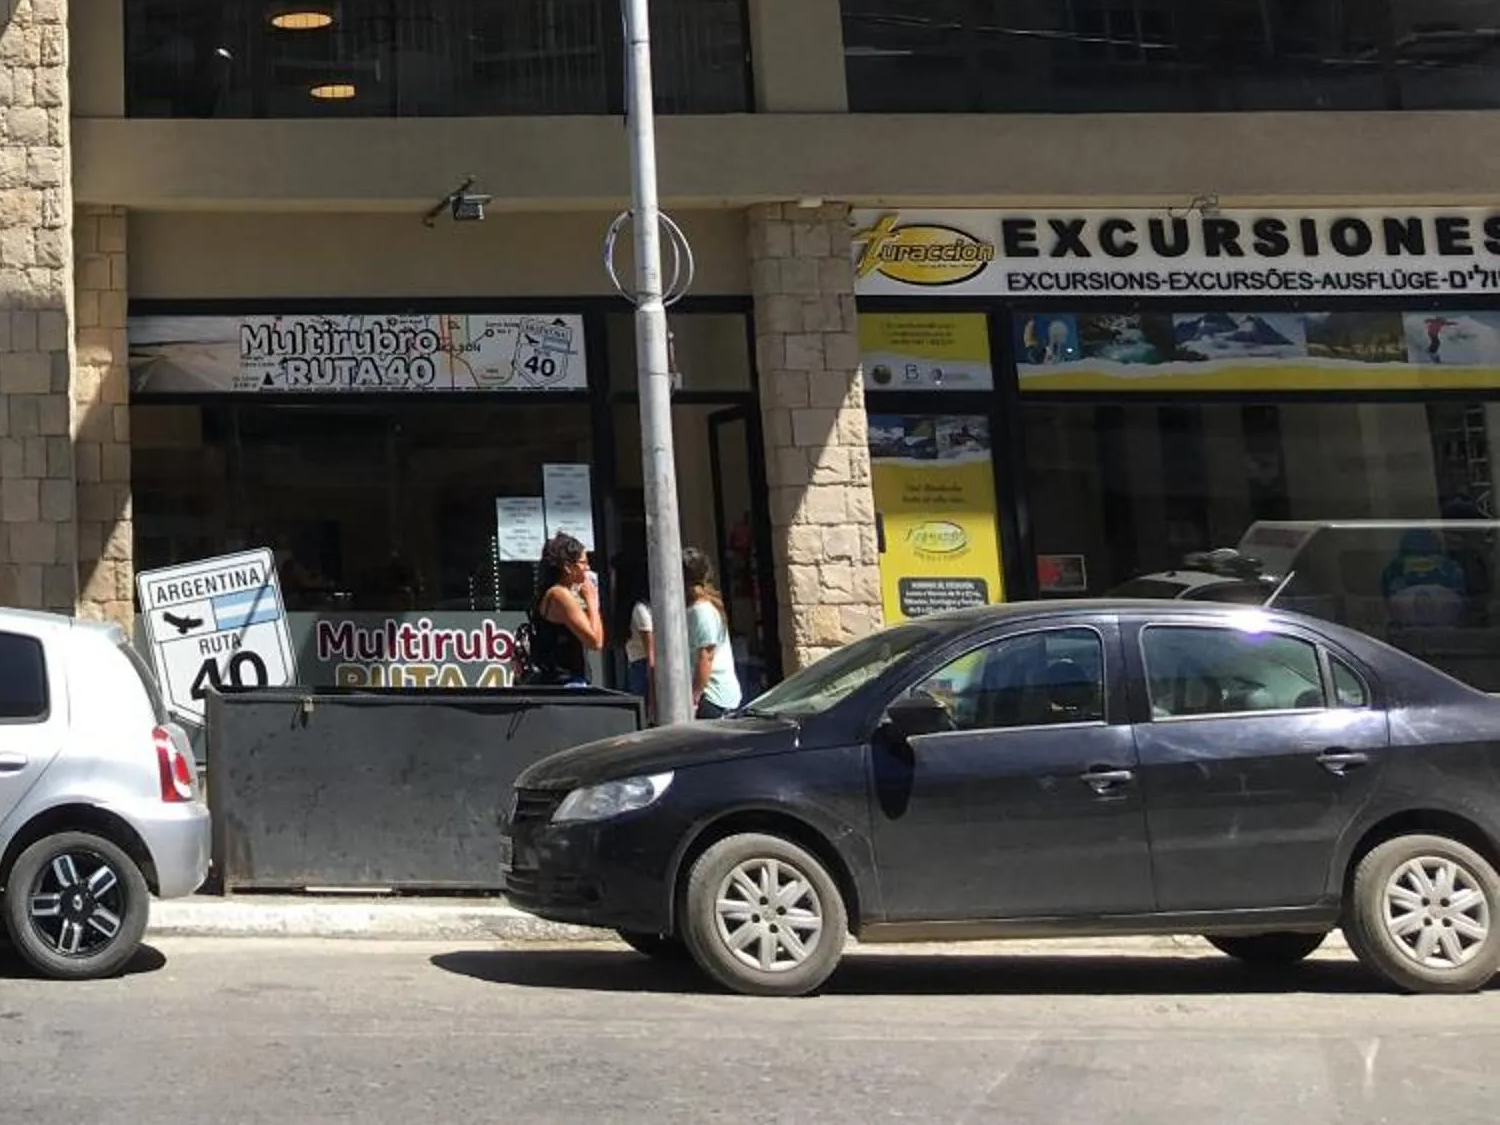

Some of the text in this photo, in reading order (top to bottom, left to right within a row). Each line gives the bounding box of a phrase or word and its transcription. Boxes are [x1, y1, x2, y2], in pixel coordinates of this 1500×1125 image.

[240, 322, 440, 356] Multirubro
[524, 356, 556, 377] 40
[156, 566, 261, 604] ARGENTINA
[199, 632, 243, 655] RUTA
[317, 618, 516, 662] Multirub
[190, 650, 269, 700] 40
